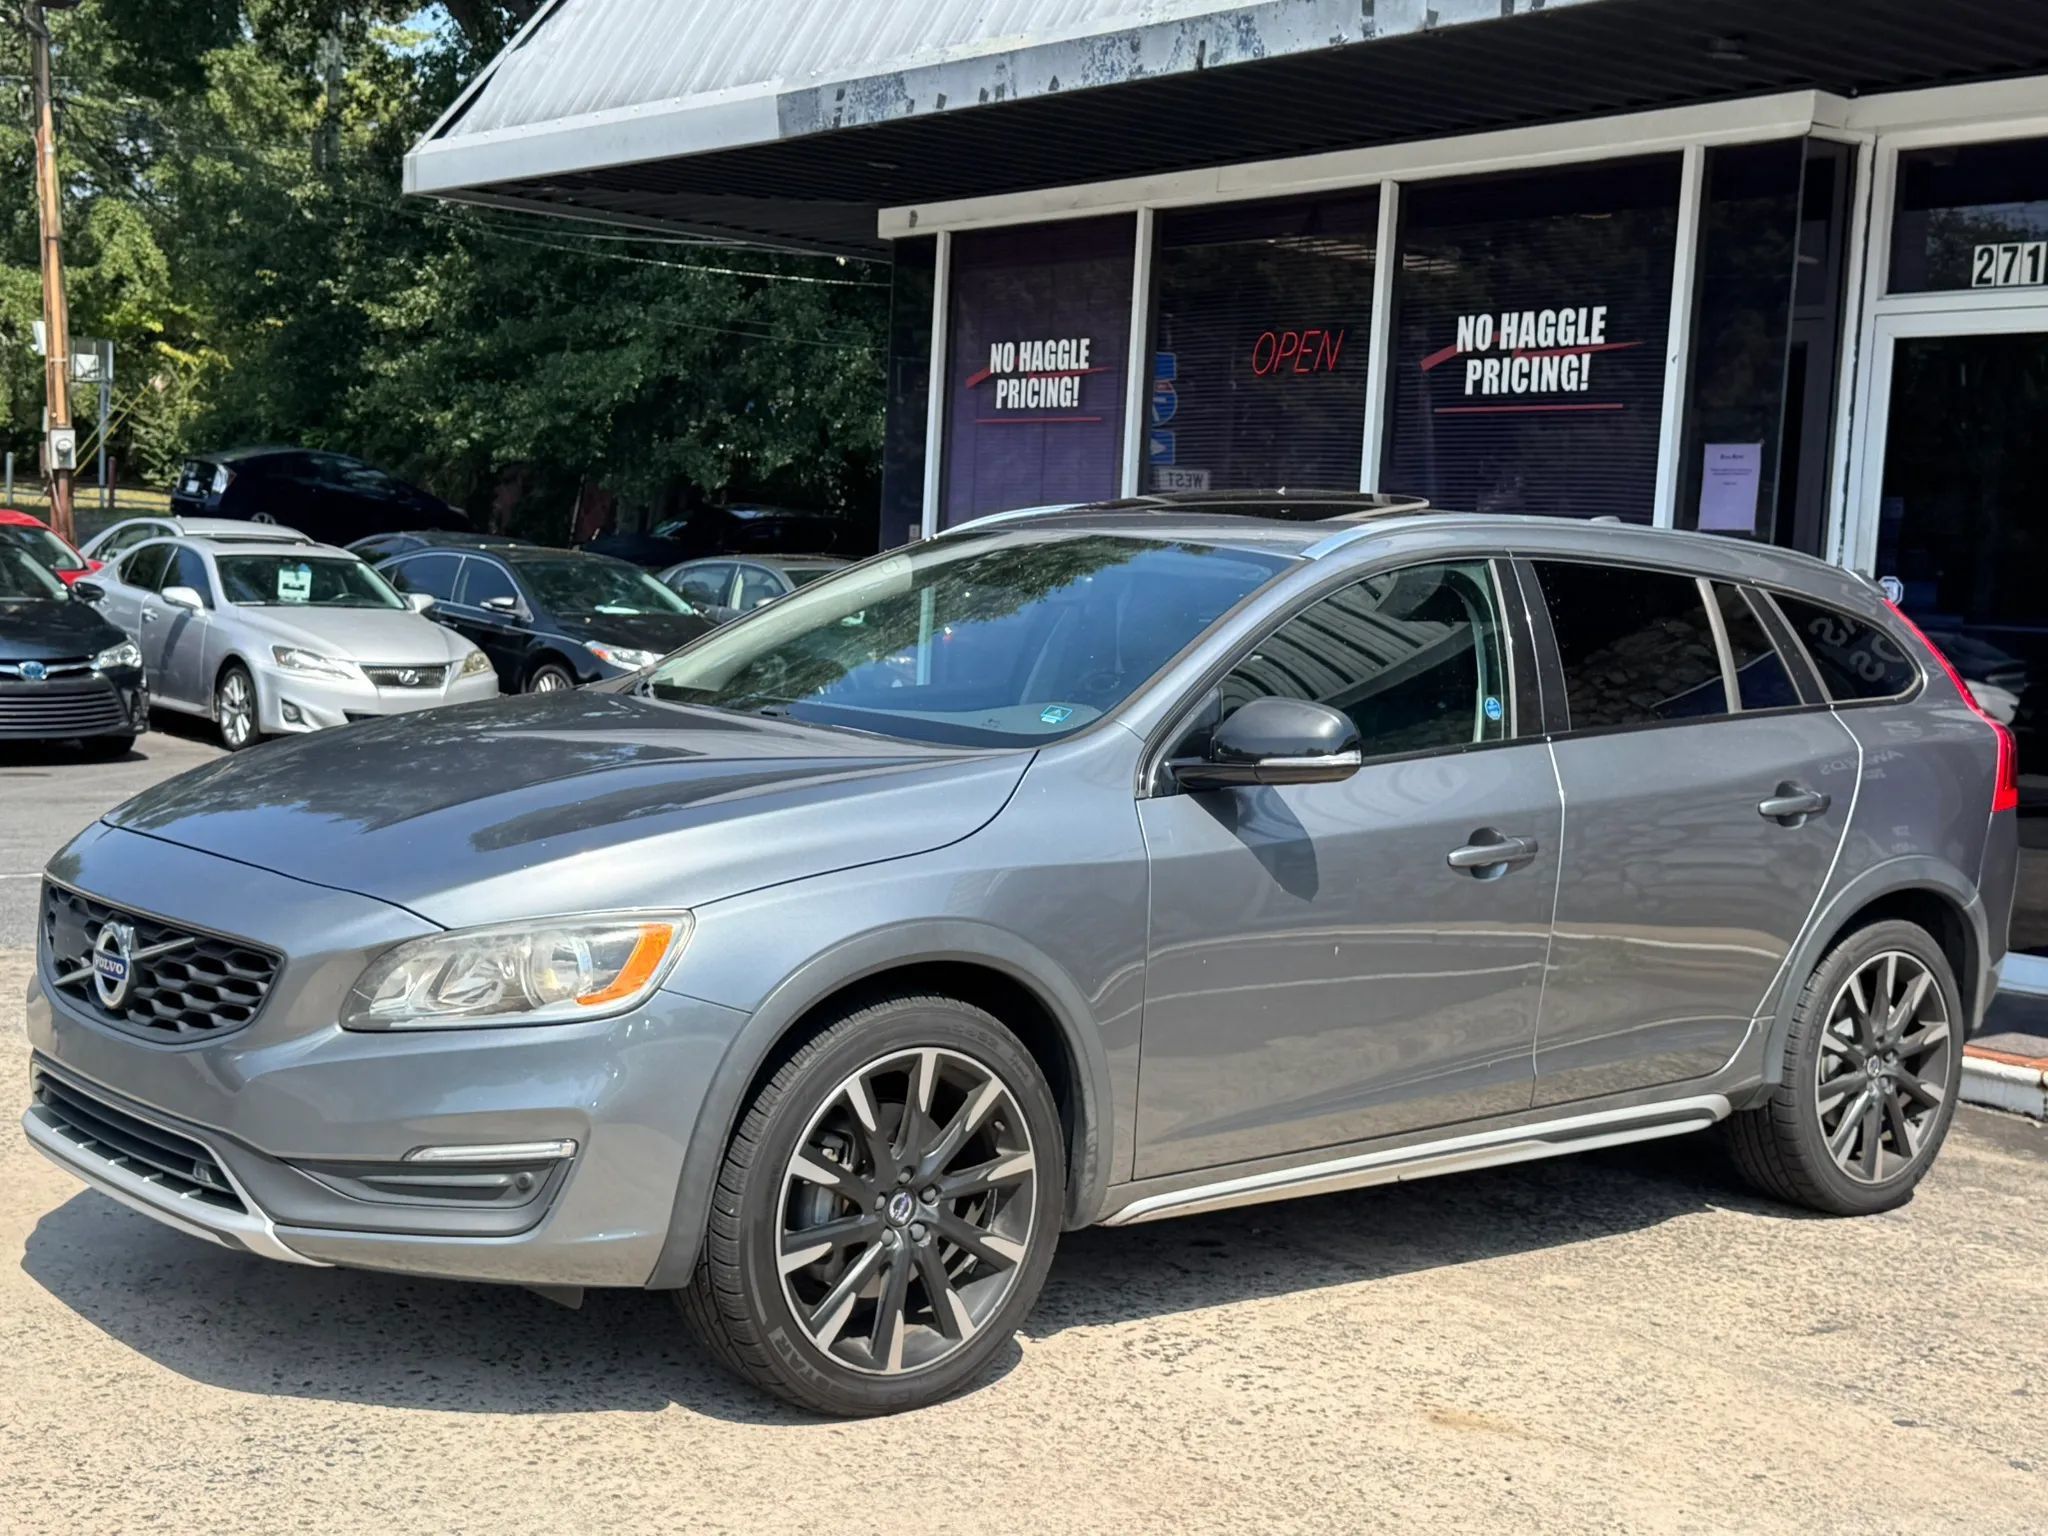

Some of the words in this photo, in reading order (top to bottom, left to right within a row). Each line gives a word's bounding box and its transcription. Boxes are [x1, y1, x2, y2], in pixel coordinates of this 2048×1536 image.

[1975, 245, 2041, 285] 271
[1457, 314, 1494, 352] NO
[1500, 306, 1607, 350] HAGGLE
[990, 342, 1015, 373] NO
[1019, 338, 1090, 372] HAGGLE
[1252, 329, 1345, 375] OPEN
[996, 376, 1080, 409] PRICING!
[1465, 353, 1591, 395] PRICING!
[96, 957, 124, 974] VOLVO
